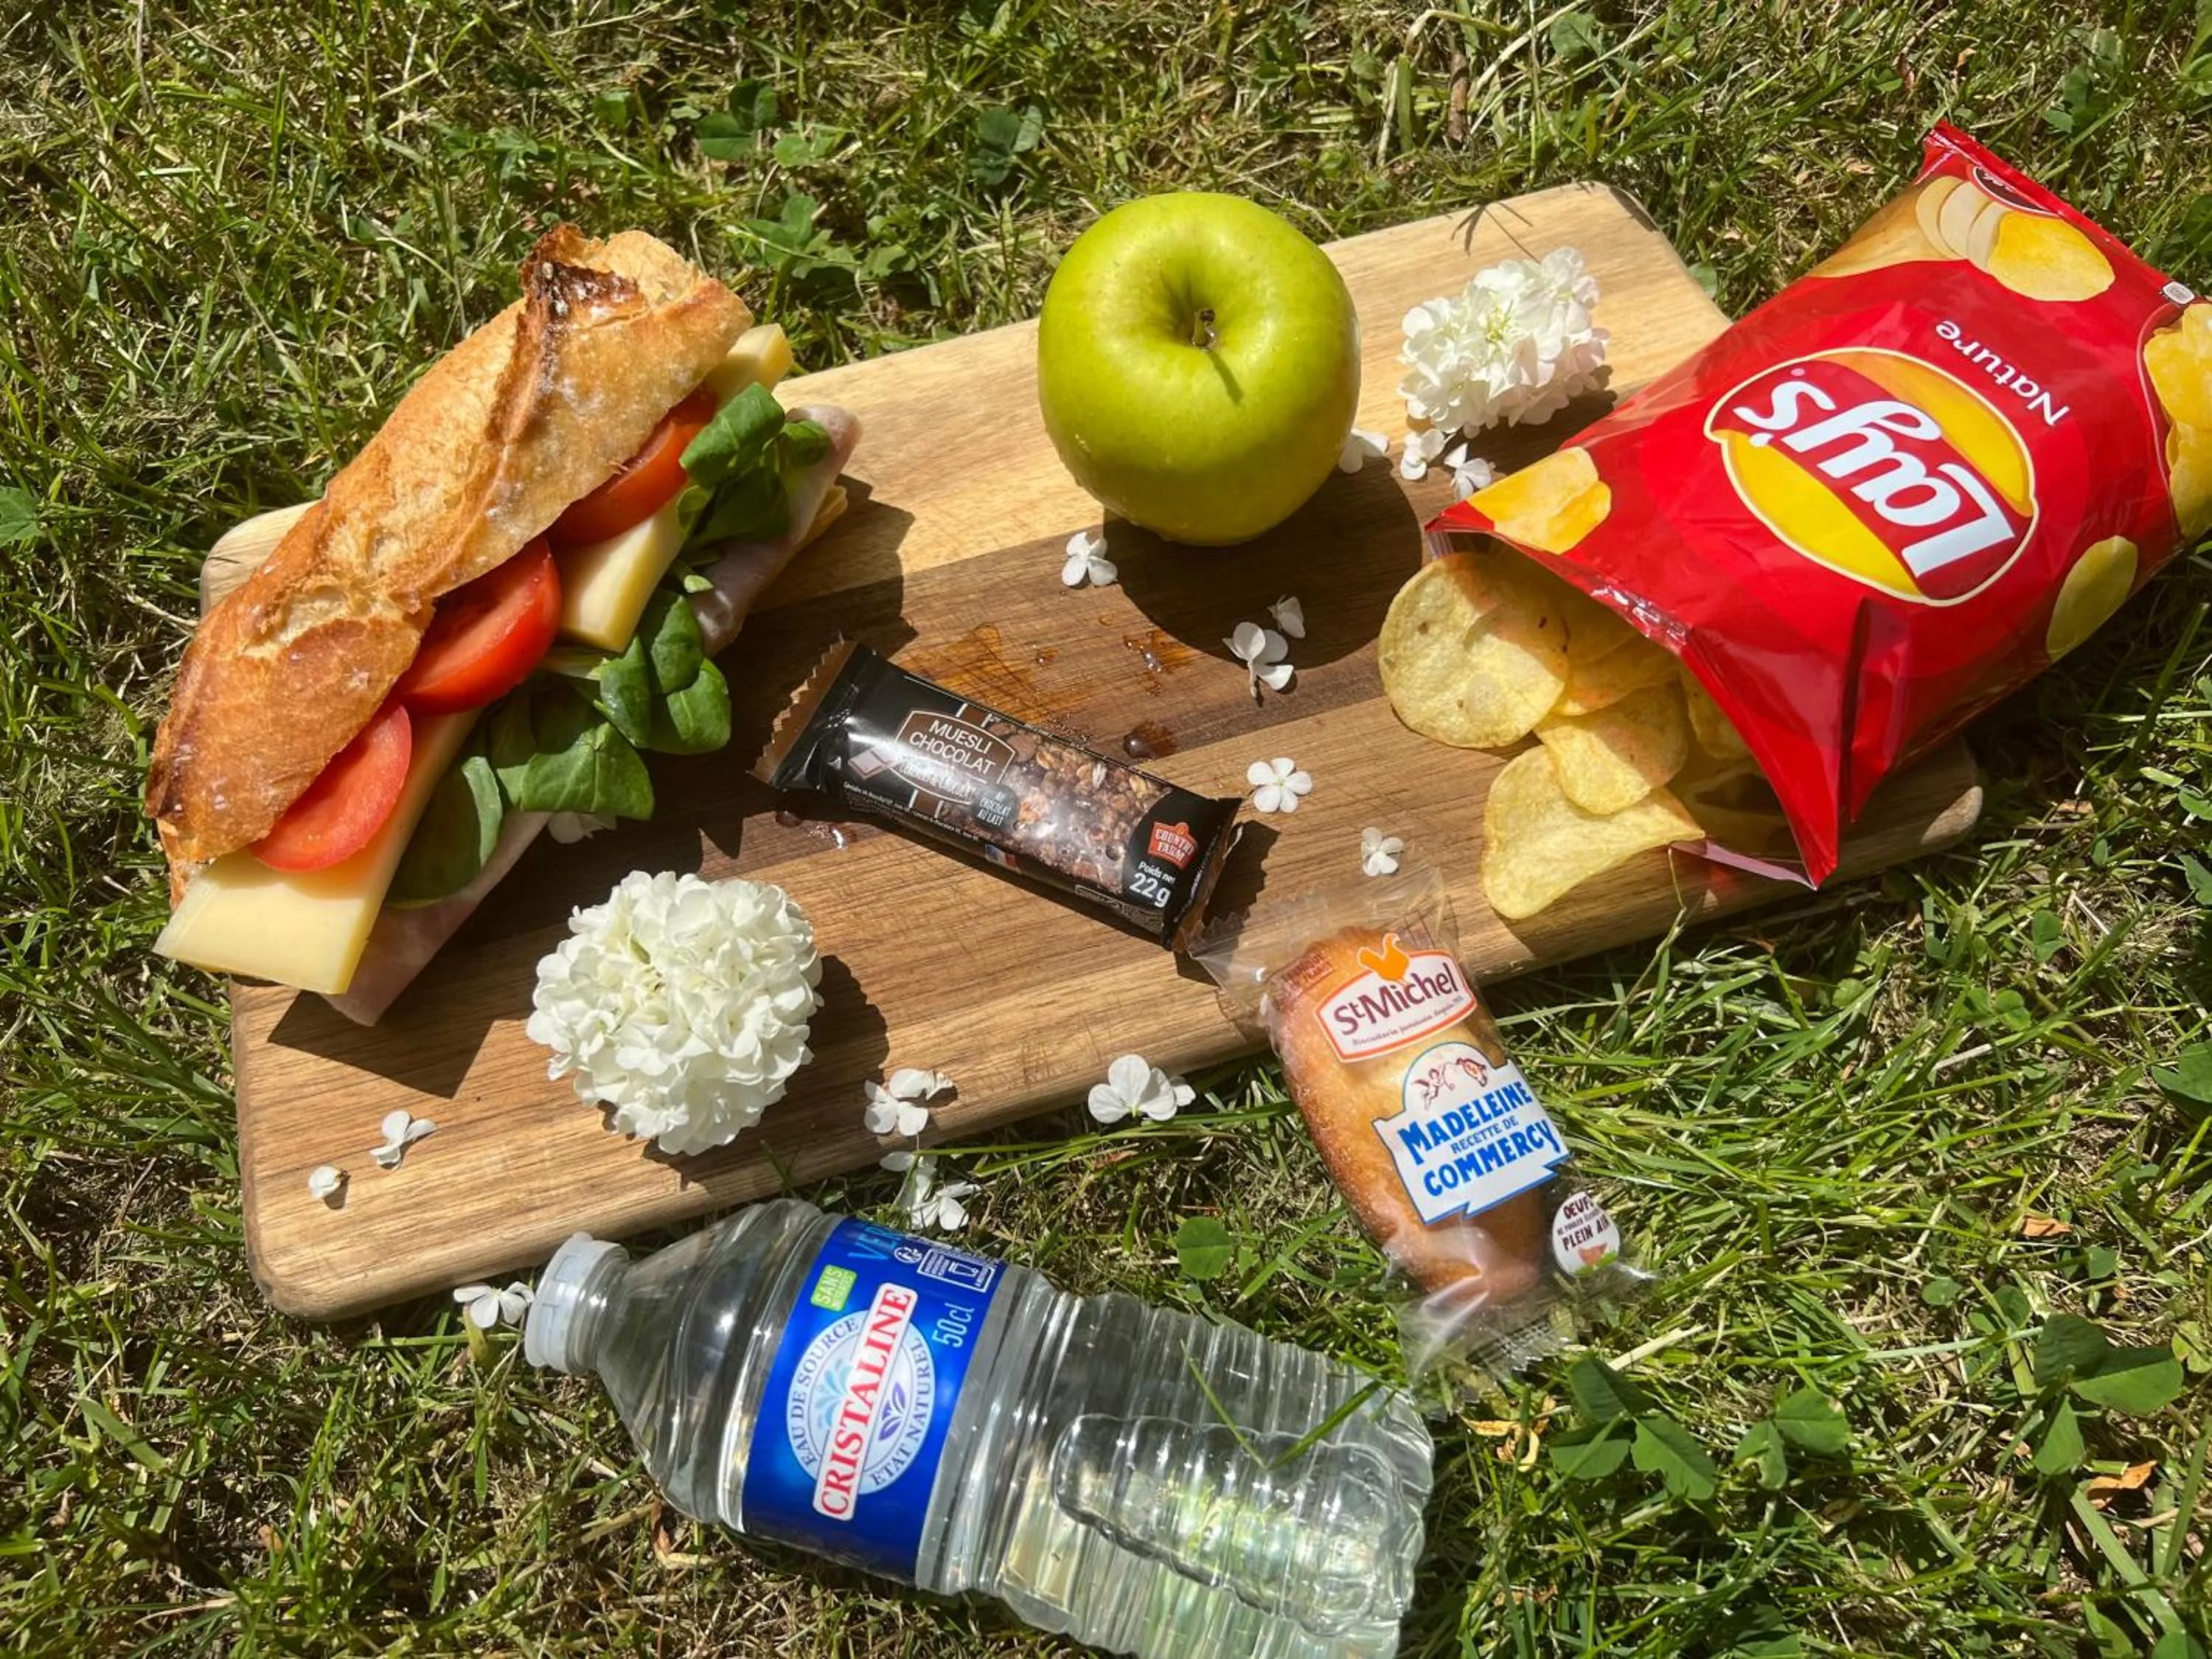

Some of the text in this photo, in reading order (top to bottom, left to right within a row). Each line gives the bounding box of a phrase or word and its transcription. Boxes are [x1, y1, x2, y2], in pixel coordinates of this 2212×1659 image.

[1934, 319, 2070, 427] Nature
[1733, 381, 2014, 578] Lay's
[909, 731, 996, 775] CHOCOLAT
[929, 720, 992, 754] MUESLI
[1138, 861, 1162, 879] Poids
[1397, 1080, 1534, 1165] MADELEINE
[1451, 1116, 1520, 1155] RECETTE DE
[1424, 1119, 1561, 1197] COMMERCY
[1562, 1225, 1594, 1251] PLEIN
[817, 1268, 843, 1304] SANS
[932, 1302, 975, 1349] 50cl
[797, 1317, 859, 1388] SOURCE
[791, 1391, 807, 1419] DE
[820, 1288, 913, 1515] CRISTALINE
[871, 1337, 932, 1486] ETAT NATUREL
[791, 1425, 817, 1467] EAU
